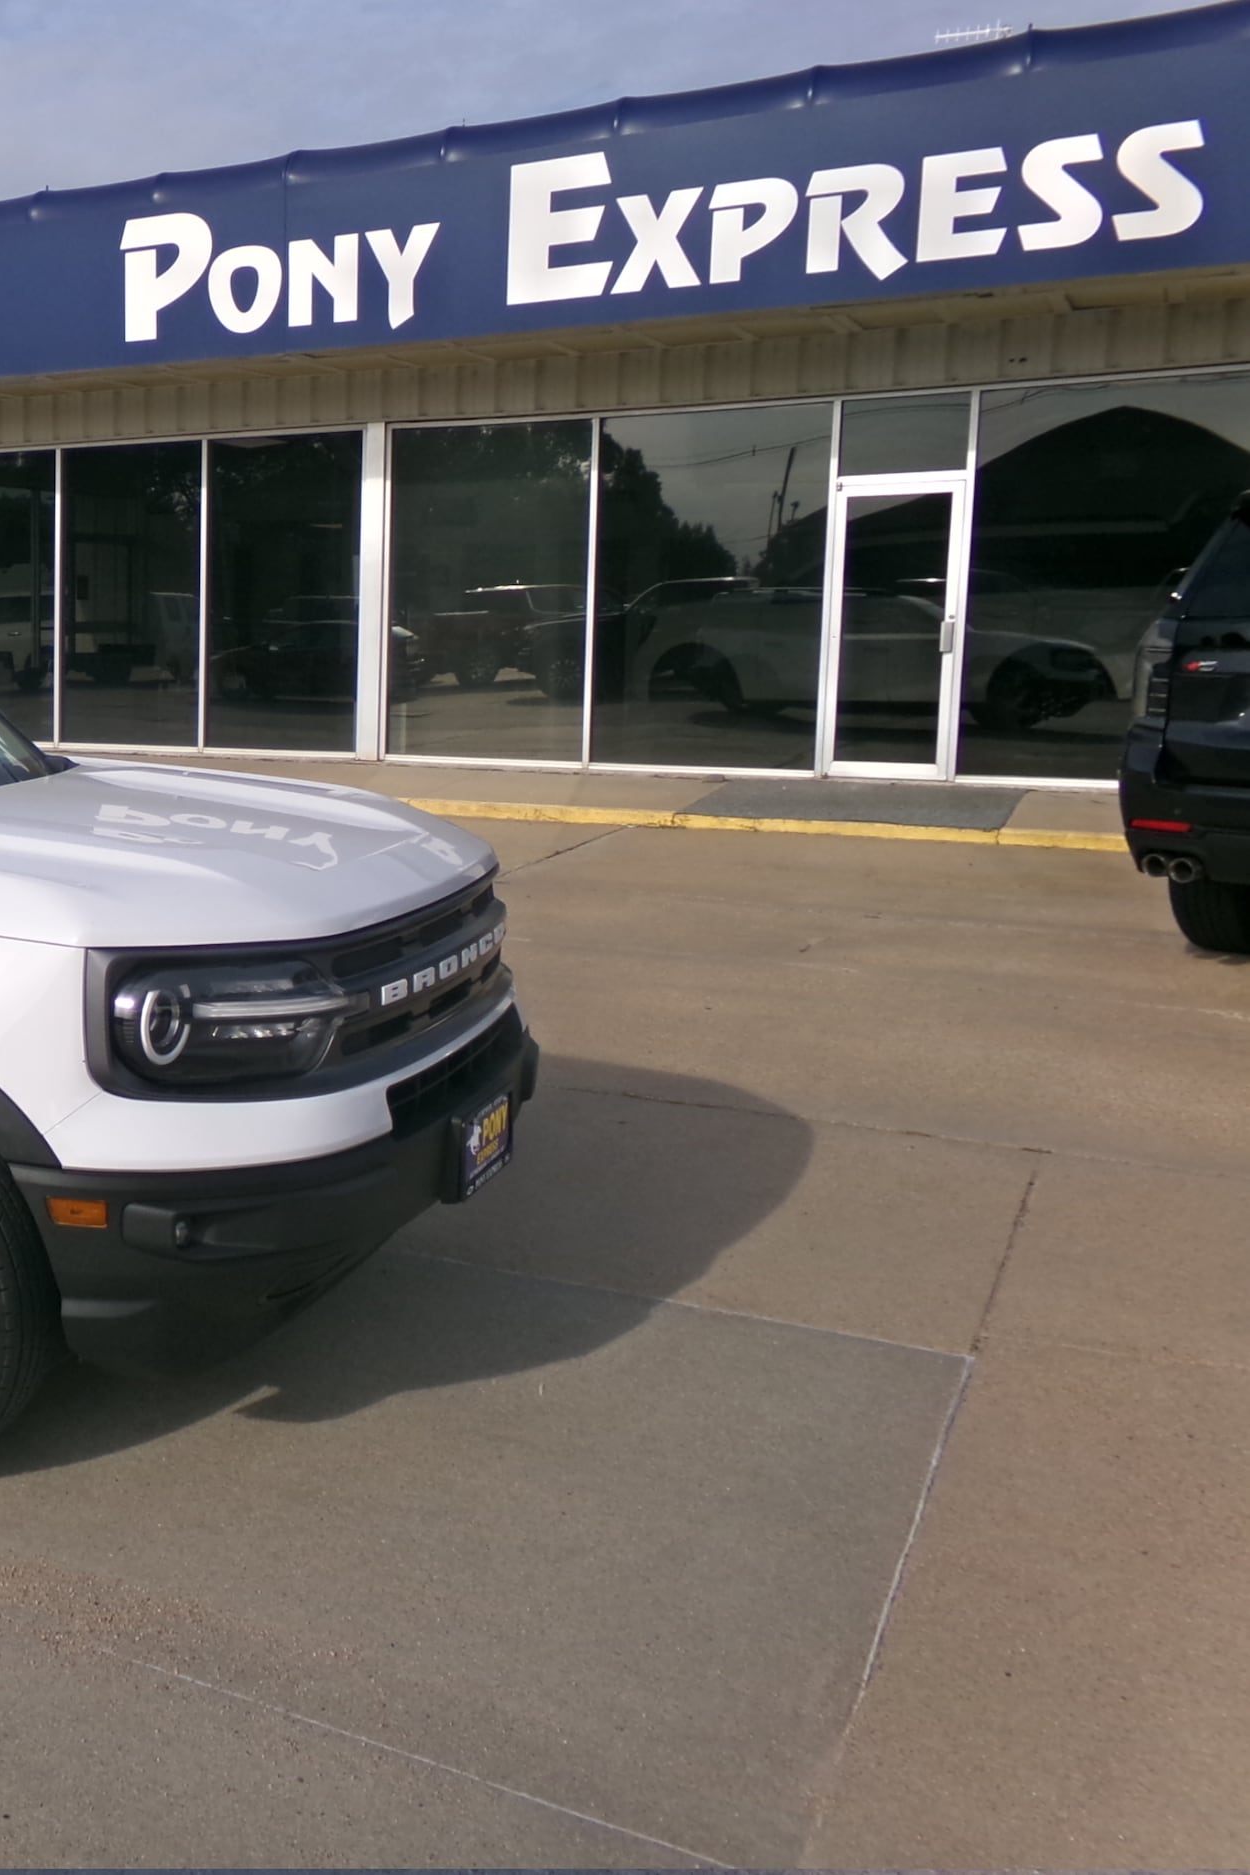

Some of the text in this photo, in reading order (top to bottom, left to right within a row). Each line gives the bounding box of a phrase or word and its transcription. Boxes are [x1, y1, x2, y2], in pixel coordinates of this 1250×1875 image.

[119, 119, 1205, 342] PONY EXPRESS
[381, 922, 506, 1006] BRONCO
[483, 1103, 508, 1147] PONY
